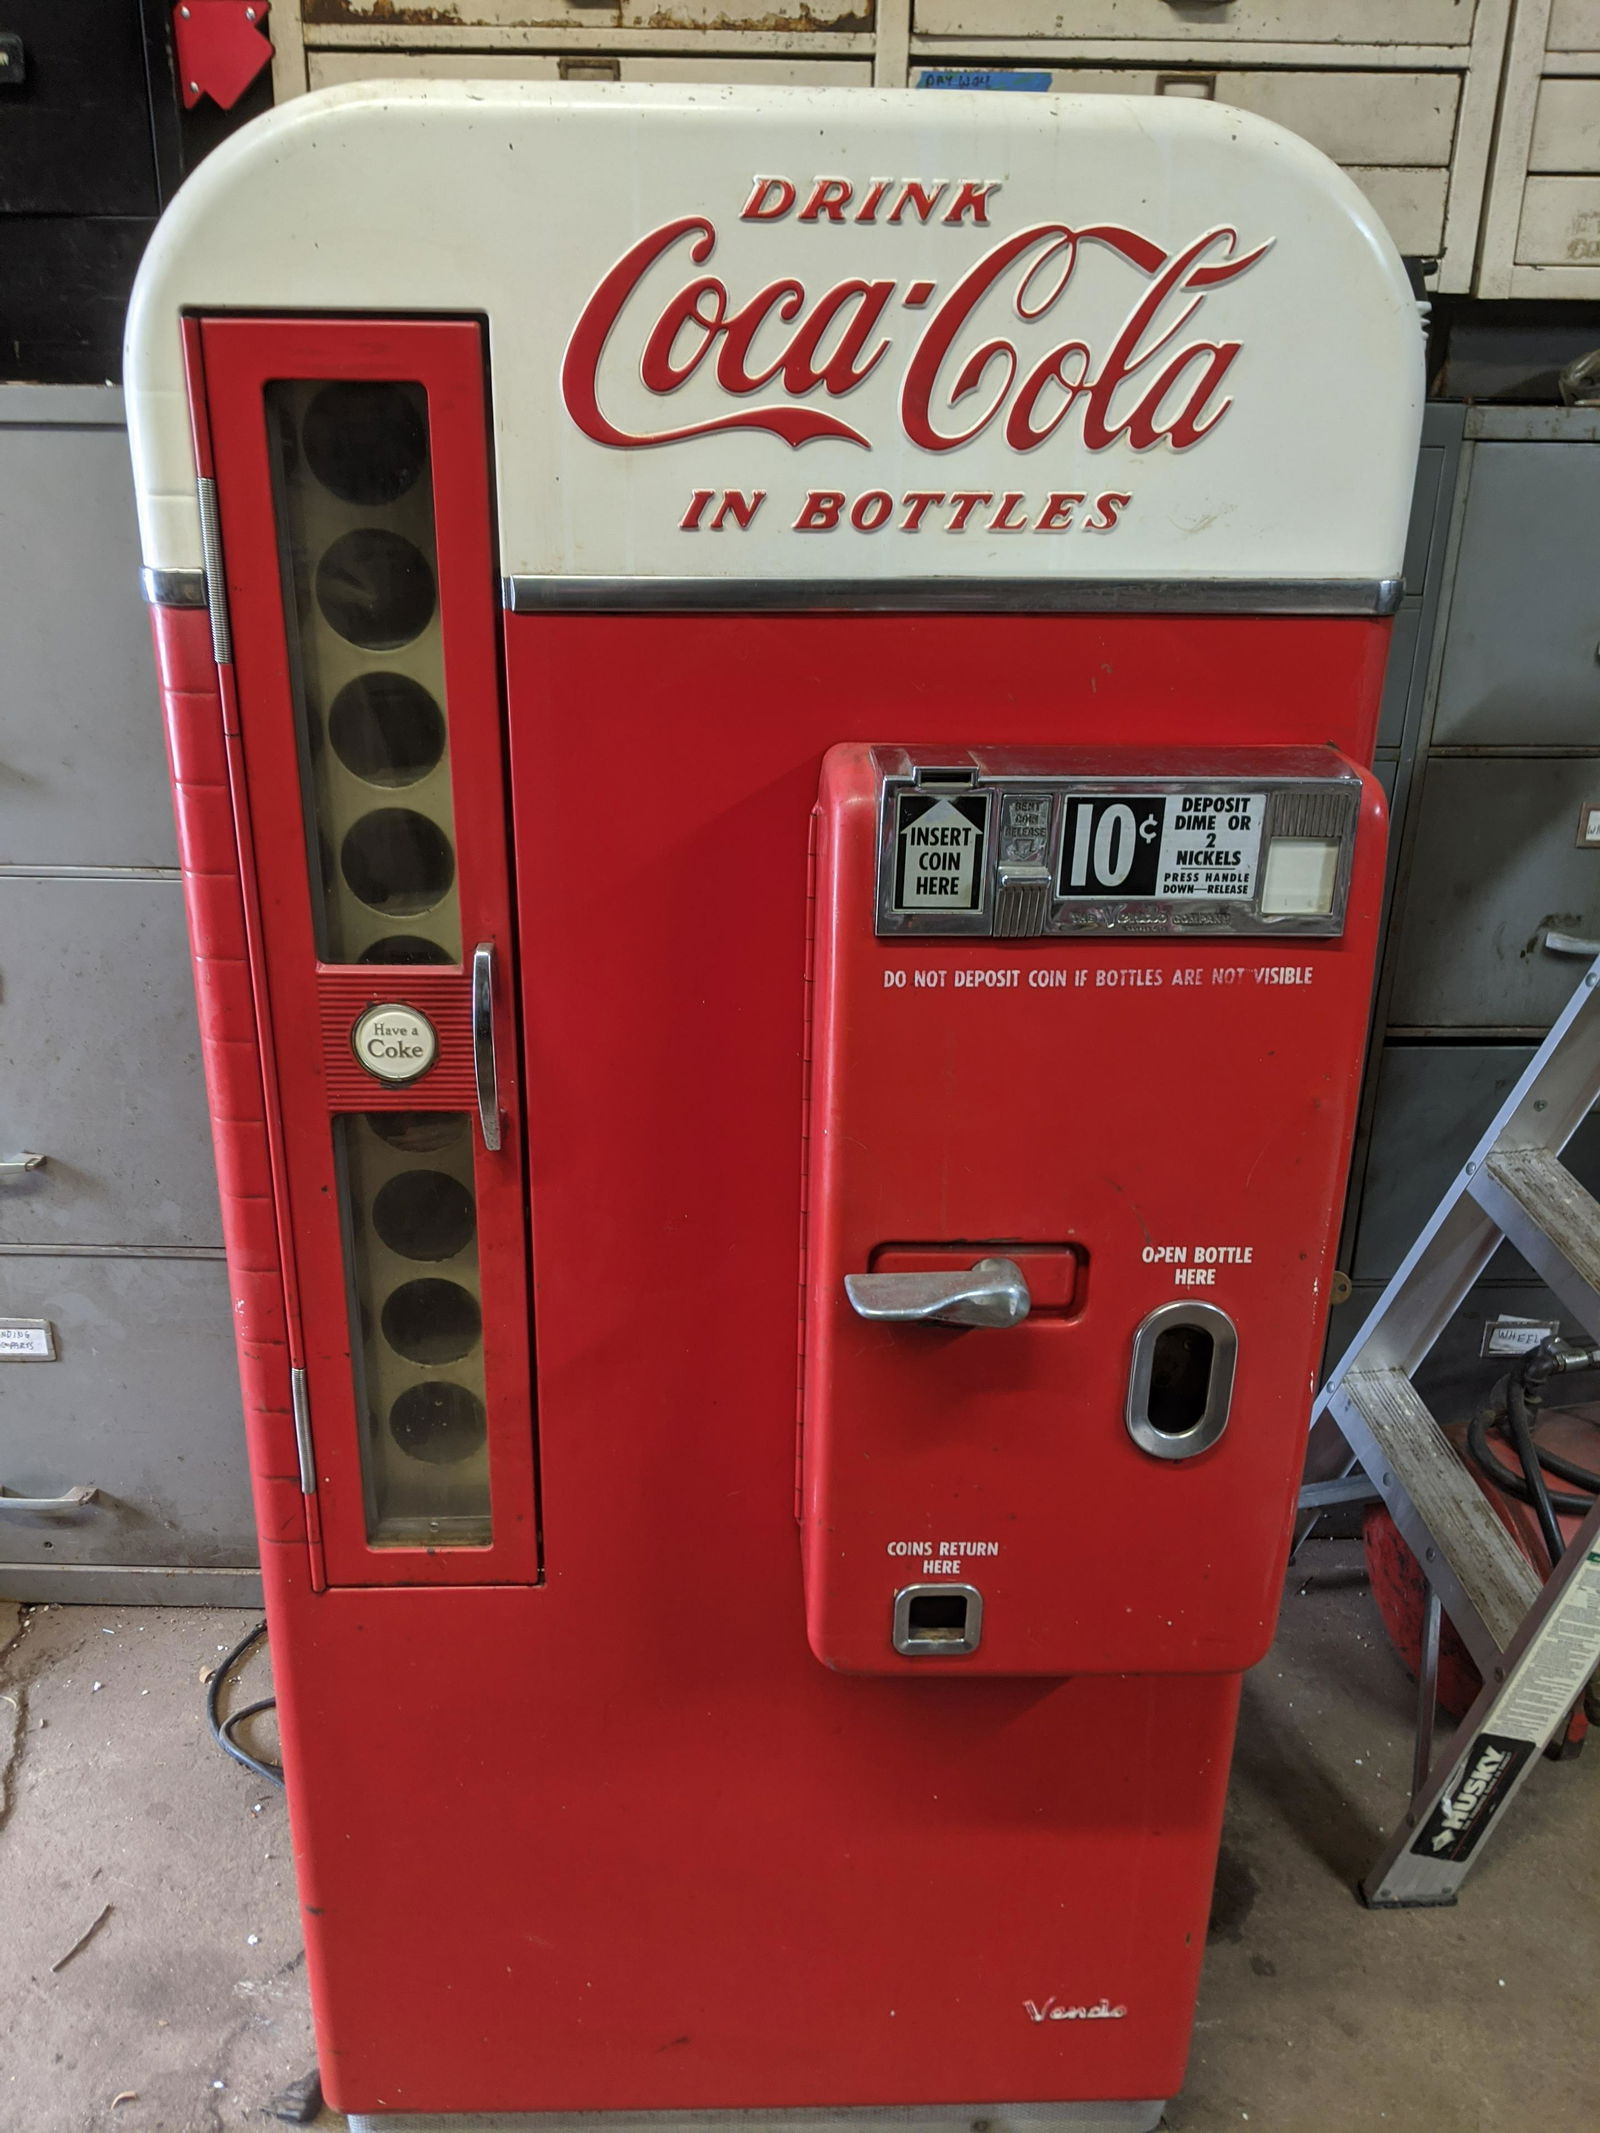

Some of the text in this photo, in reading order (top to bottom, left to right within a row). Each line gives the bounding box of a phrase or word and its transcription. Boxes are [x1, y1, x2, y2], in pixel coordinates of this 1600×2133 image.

[739, 174, 1003, 225] DRINK
[561, 213, 1277, 455] Coca-Cola
[678, 488, 1133, 535] IN BOTTLES
[1181, 797, 1251, 813] DEPOSIT
[1004, 826, 1047, 838] RELEASE
[1174, 815, 1252, 831] DIME OR
[910, 826, 972, 847] INSERT
[1205, 833, 1216, 849] 2
[919, 852, 961, 871] COIN
[1176, 850, 1242, 866] NICKELS
[916, 876, 960, 896] HERE
[1164, 872, 1250, 883] PRESS HANDLE
[883, 966, 1313, 988] DO NOT DEPOSIT COIN IF BOTTLES ARE NOT VISIBLE
[374, 1023, 419, 1036] Have a
[367, 1038, 424, 1059] Coke
[1142, 1246, 1253, 1264] OPEN BOTTLE
[1175, 1268, 1217, 1285] HERE
[887, 1541, 999, 1557] COINS RETURN
[922, 1559, 961, 1574] HERE
[1441, 1745, 1504, 1830] HUSKY
[1022, 1996, 1127, 2021] Vendo
